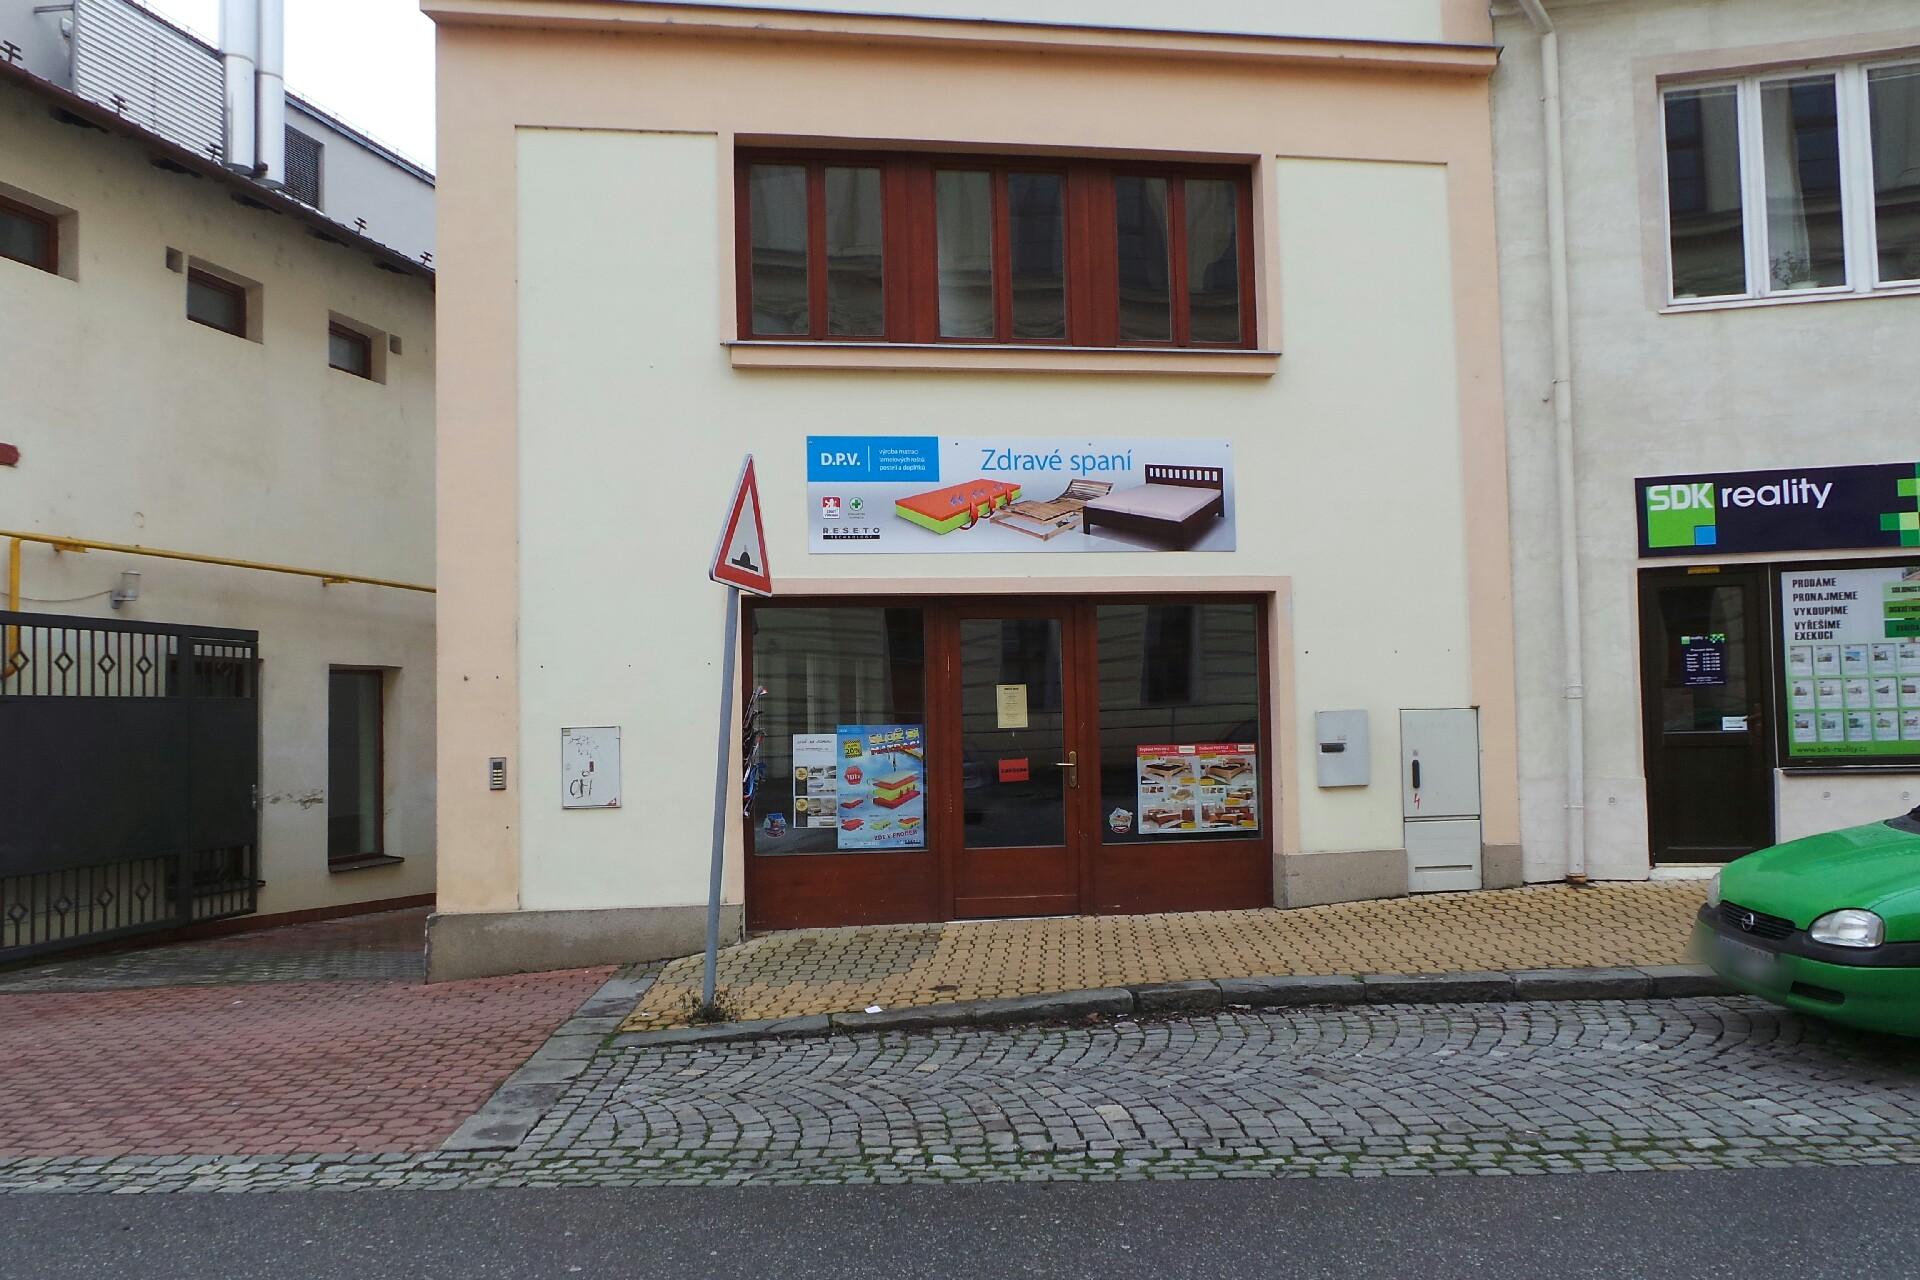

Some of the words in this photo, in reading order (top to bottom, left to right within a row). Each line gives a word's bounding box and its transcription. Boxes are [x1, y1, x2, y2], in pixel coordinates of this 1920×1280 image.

[820, 452, 861, 466] D.P.V.
[980, 448, 1062, 471] Zdravé
[1069, 449, 1132, 476] spaní
[1649, 483, 1714, 511] SDK
[1721, 478, 1833, 509] reality
[1792, 576, 1837, 588] PRODÁME
[1792, 591, 1859, 602] PRONAJMEME
[1793, 605, 1849, 616] VYKOUPÍME
[1794, 619, 1841, 630] VYŘEŠÍME
